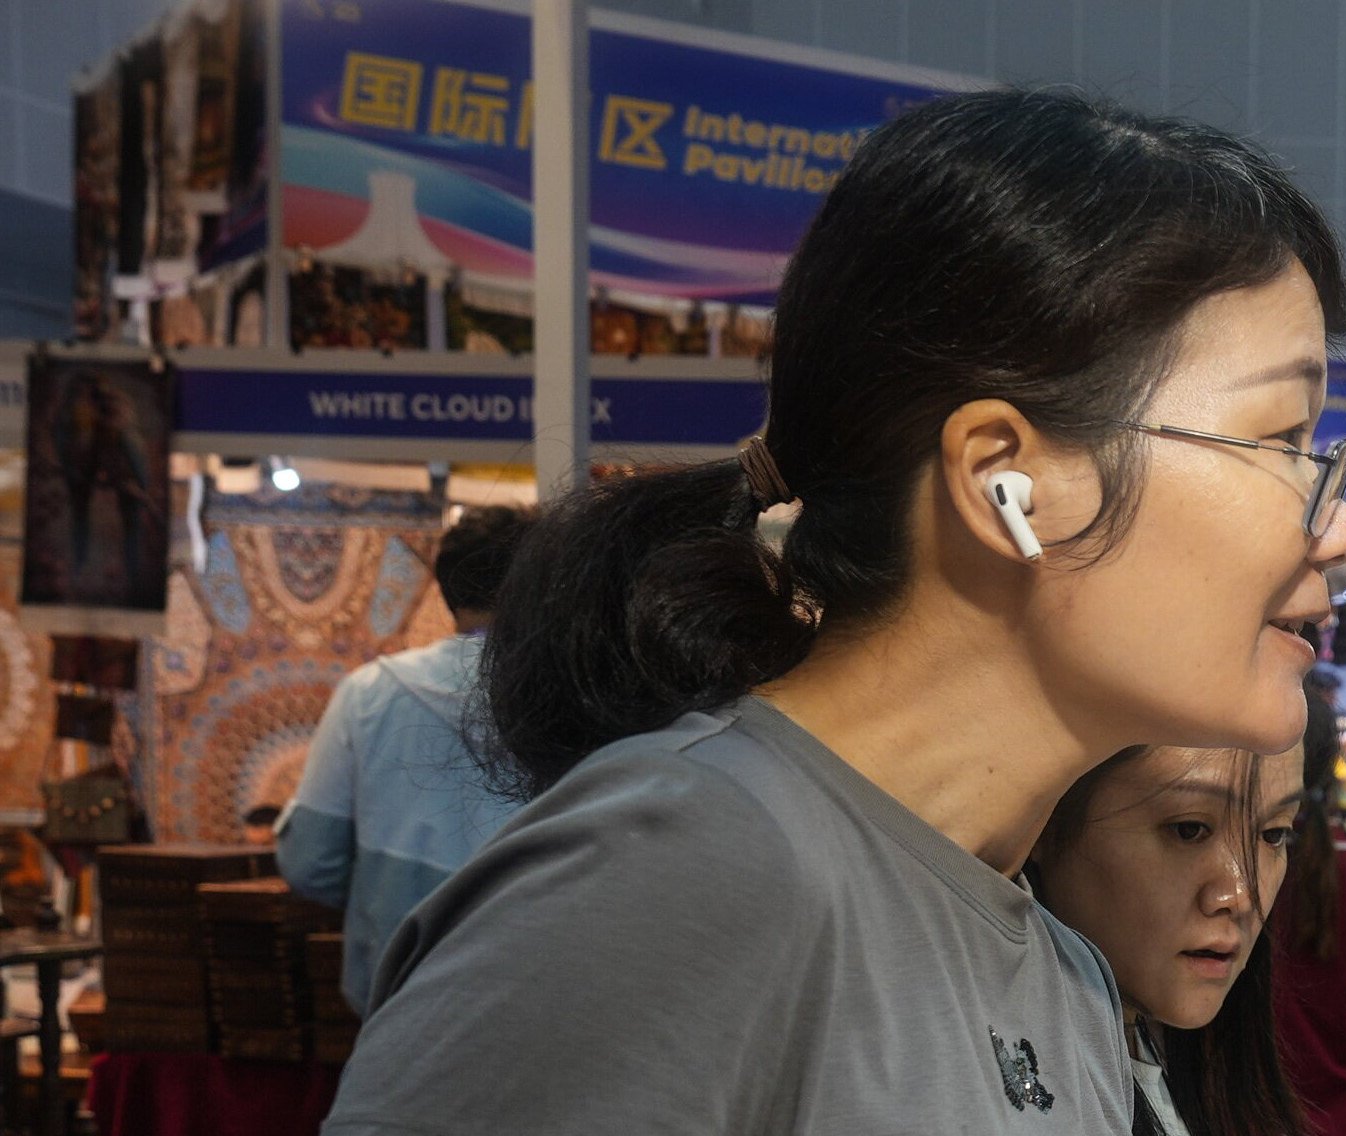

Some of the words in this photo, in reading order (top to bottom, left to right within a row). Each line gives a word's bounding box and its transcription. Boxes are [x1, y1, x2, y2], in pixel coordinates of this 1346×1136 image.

[340, 49, 672, 171] 国际区
[308, 390, 406, 420] WHITE
[409, 393, 516, 422] CLOUD
